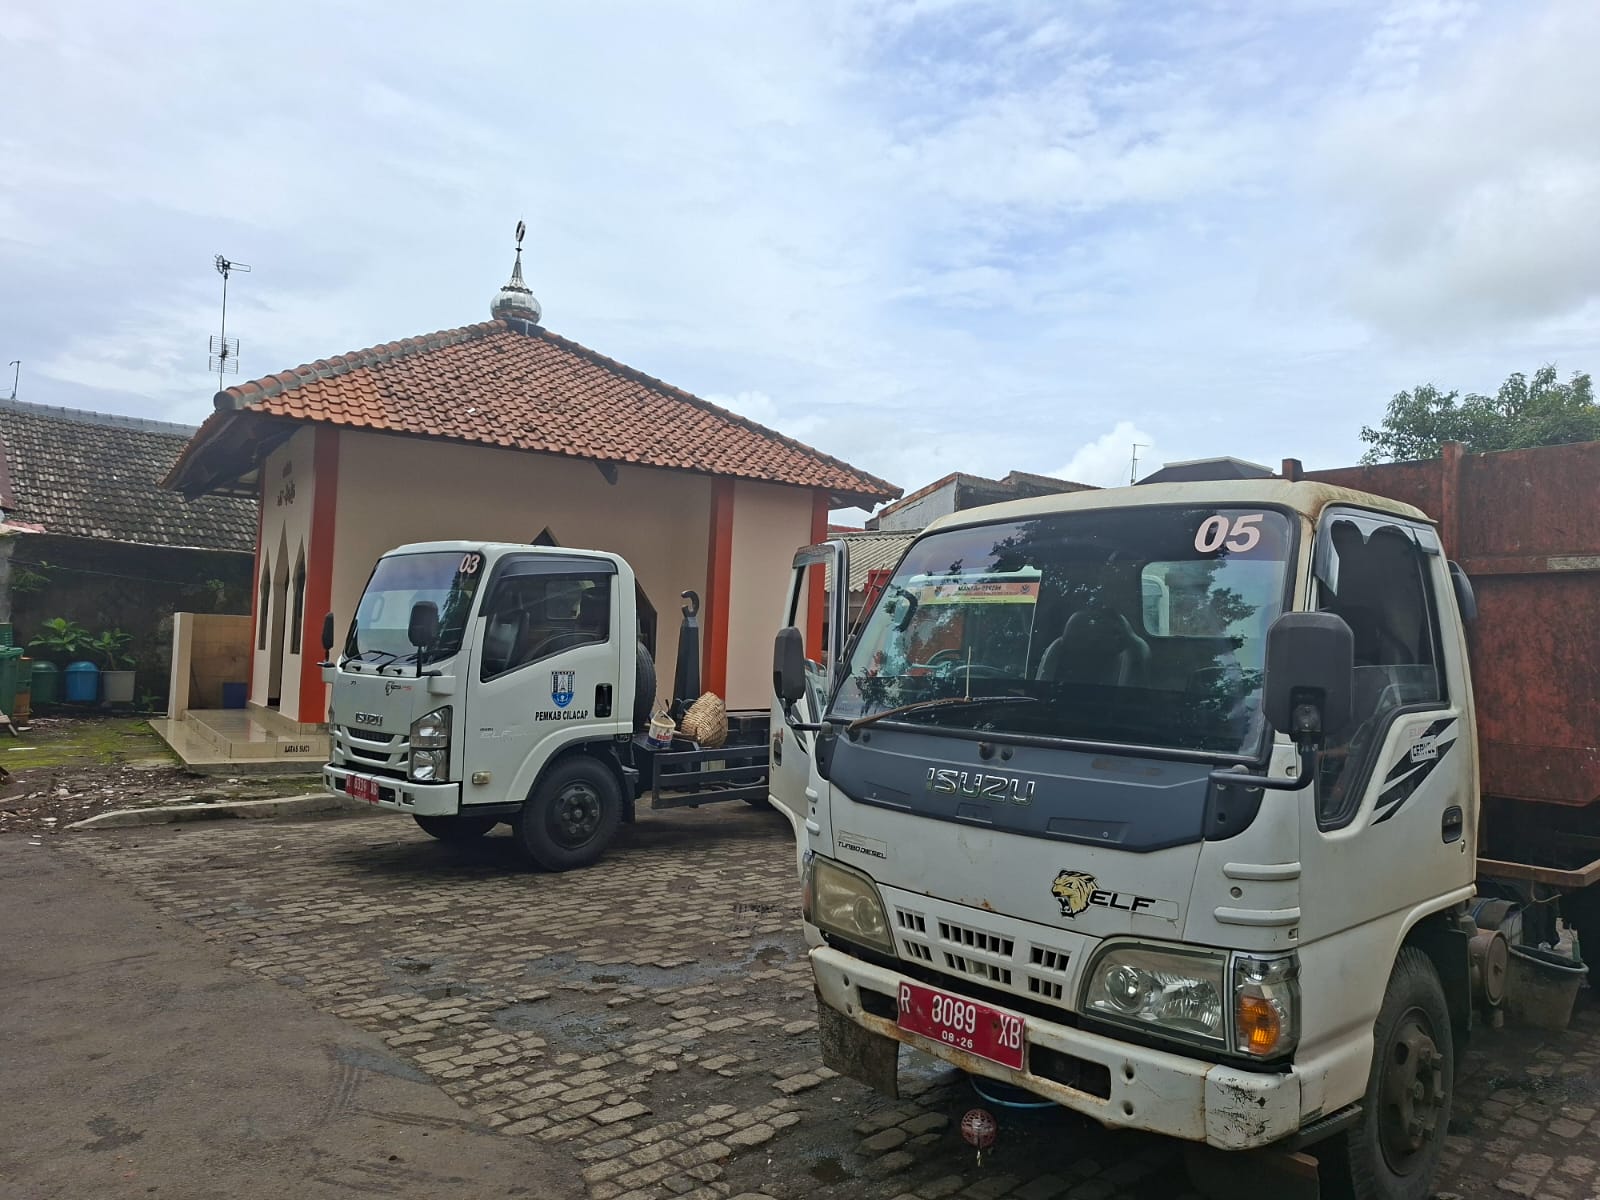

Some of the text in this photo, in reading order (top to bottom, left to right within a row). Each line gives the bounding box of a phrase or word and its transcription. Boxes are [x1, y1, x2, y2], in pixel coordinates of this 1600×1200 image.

[1194, 513, 1264, 553] 05
[459, 554, 480, 573] 03
[355, 711, 383, 727] ISUZU
[535, 710, 589, 721] PEMKAB CILACAP
[927, 767, 1036, 806] ISUZU
[1089, 889, 1156, 911] ELF
[900, 984, 1021, 1049] R 3089 XB
